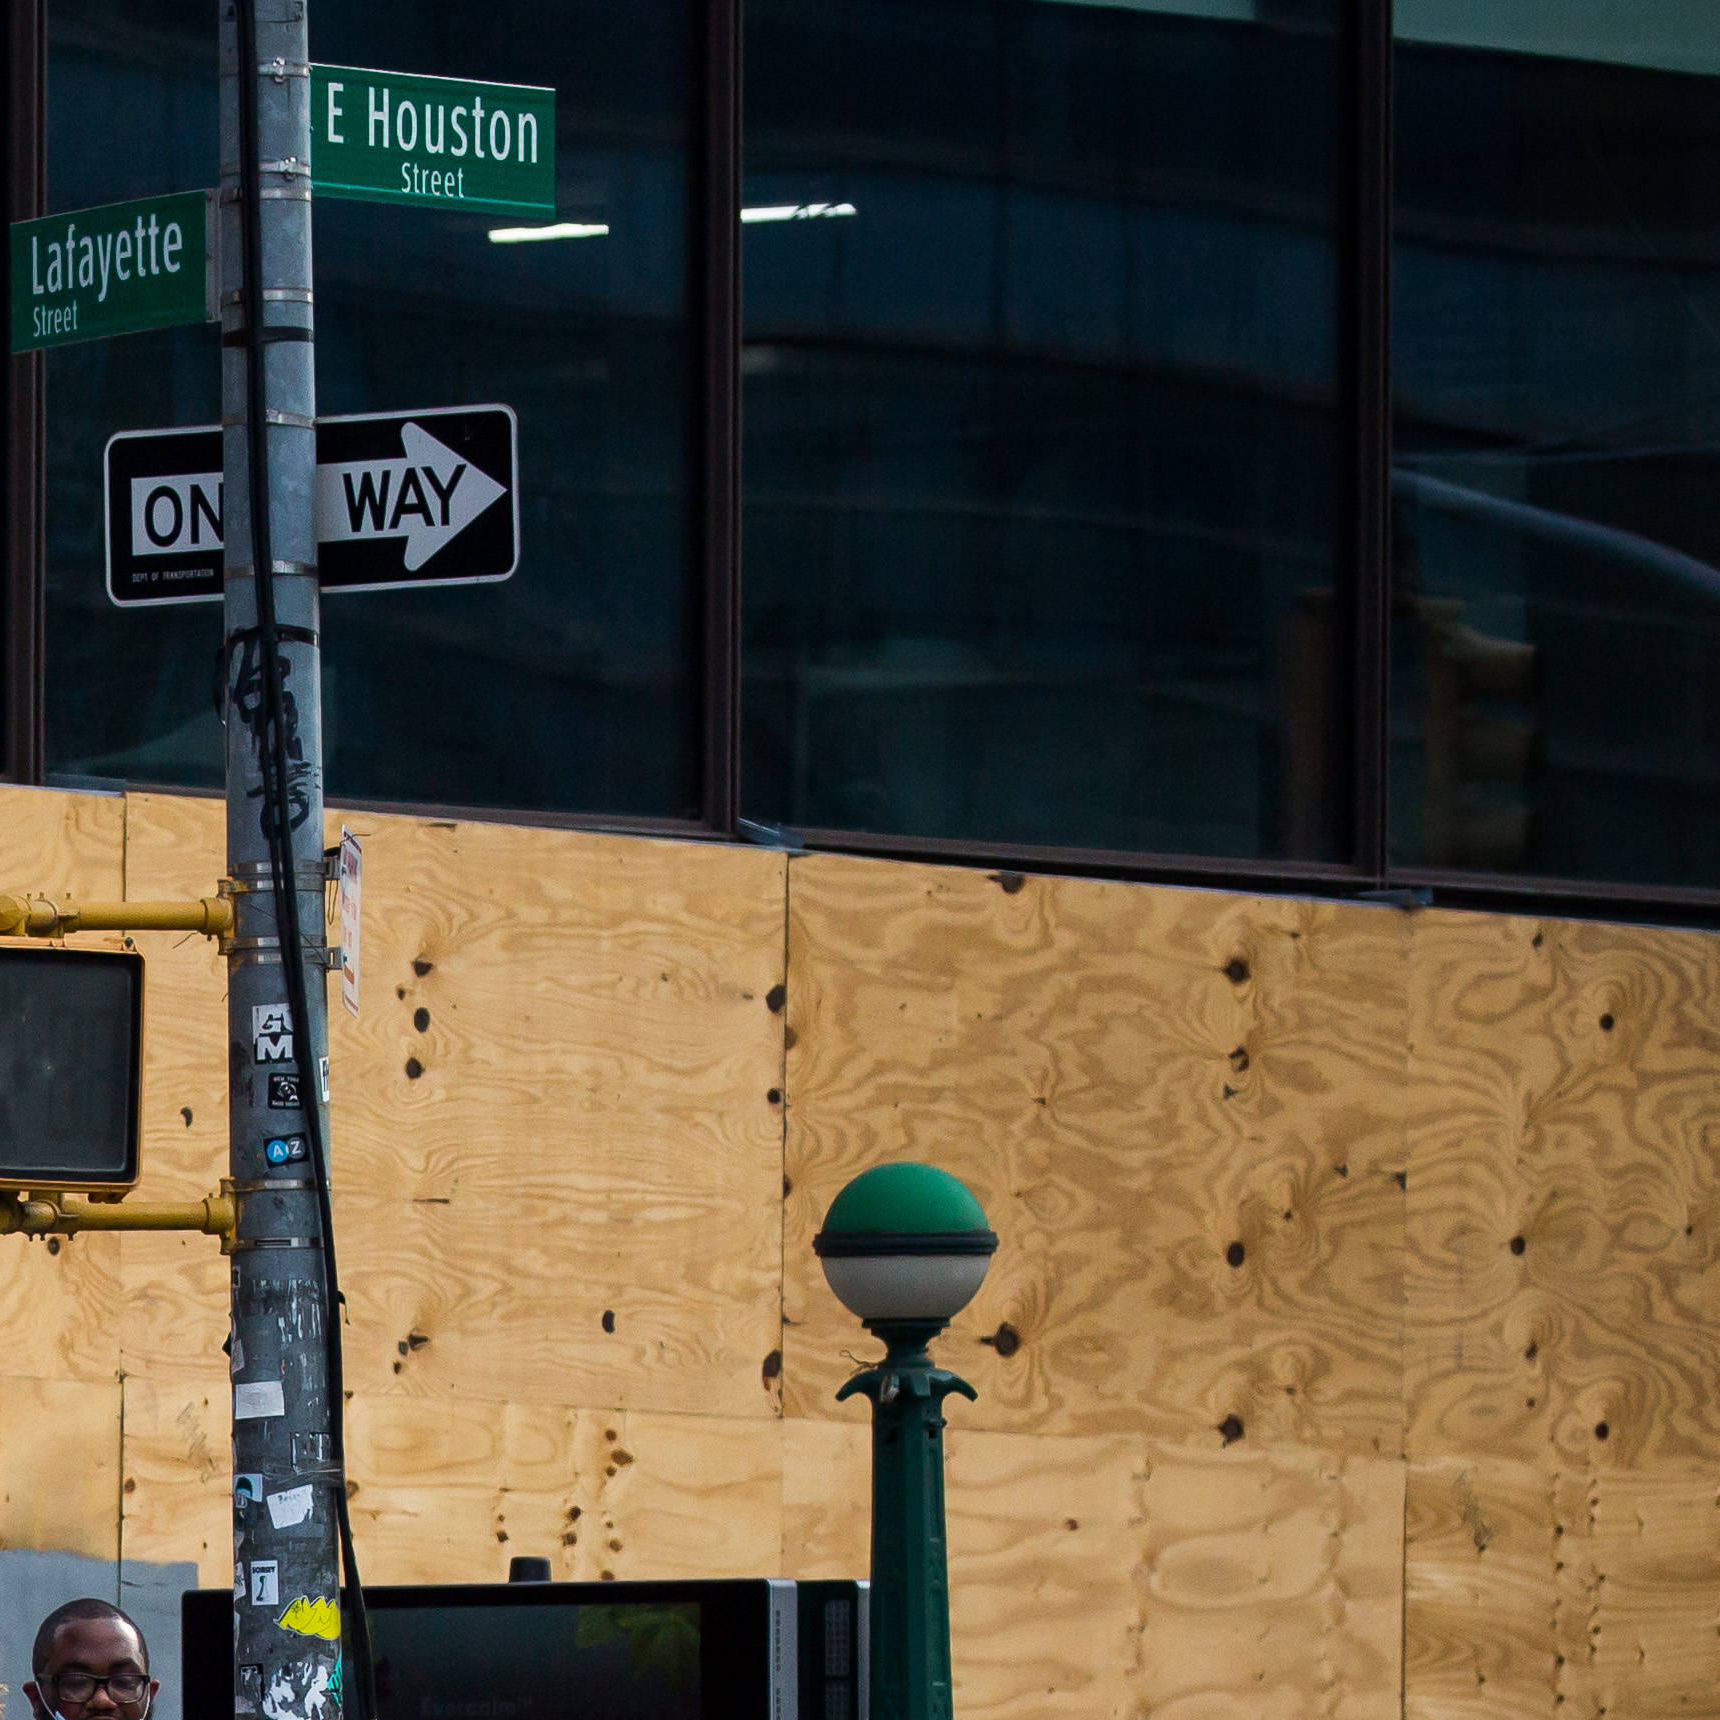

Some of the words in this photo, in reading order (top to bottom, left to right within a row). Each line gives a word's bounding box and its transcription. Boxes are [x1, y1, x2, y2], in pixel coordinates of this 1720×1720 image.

[327, 83, 344, 144] E
[367, 86, 538, 164] Houston
[401, 161, 464, 199] Street
[32, 214, 183, 302] Lafayette
[33, 301, 79, 338] Street
[145, 484, 224, 549] ON
[342, 463, 467, 534] WAY
